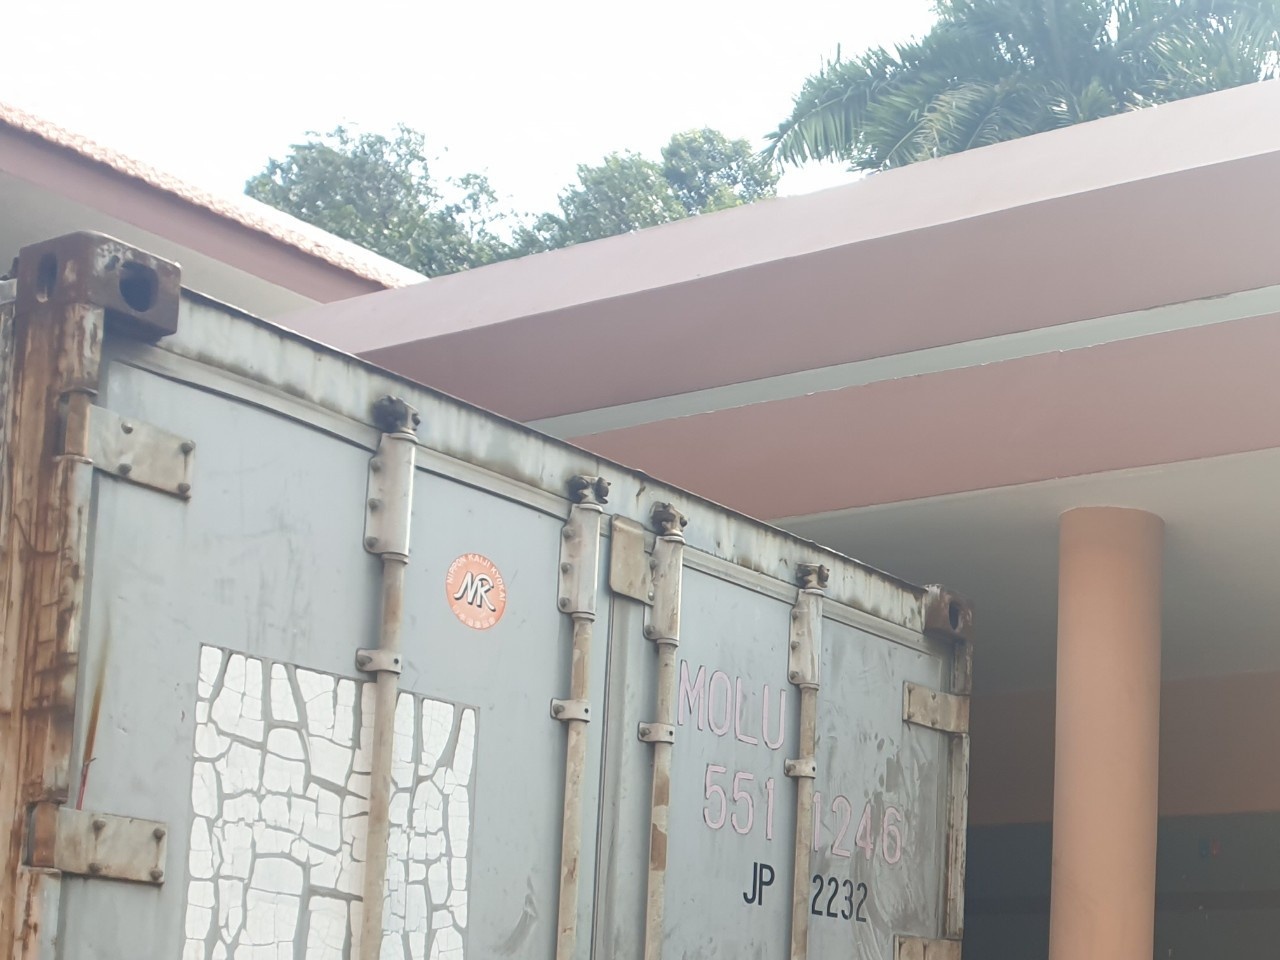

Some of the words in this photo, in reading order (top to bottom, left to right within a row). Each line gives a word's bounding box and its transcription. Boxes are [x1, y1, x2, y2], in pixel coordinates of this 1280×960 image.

[468, 552, 491, 569] KAIJI
[677, 658, 787, 750] MOLU
[702, 762, 774, 841] 551
[742, 861, 775, 906] JP
[810, 874, 868, 923] 2232
